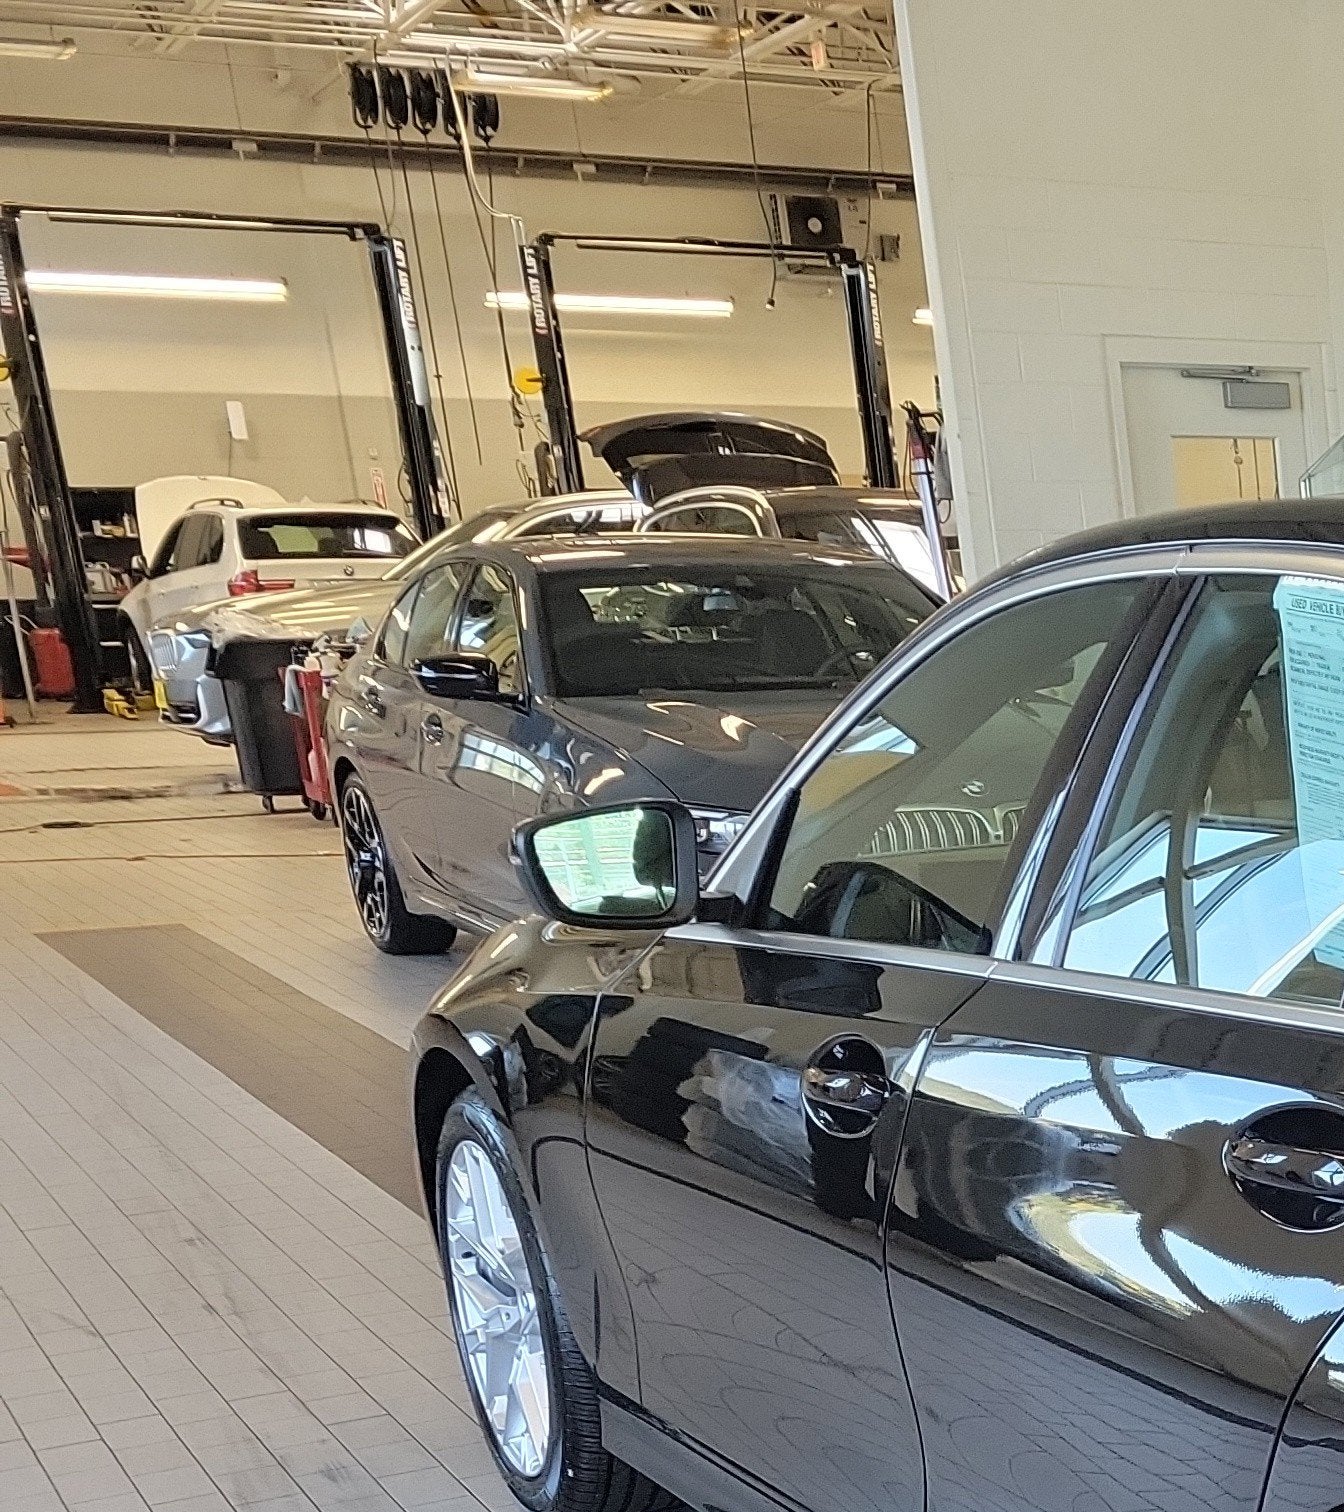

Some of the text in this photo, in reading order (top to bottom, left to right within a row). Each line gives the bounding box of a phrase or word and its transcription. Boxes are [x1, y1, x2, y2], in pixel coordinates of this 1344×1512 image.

[524, 247, 547, 329] ROTARY LIFT
[1291, 597, 1308, 610] USED
[1309, 600, 1335, 615] VEHICLE
